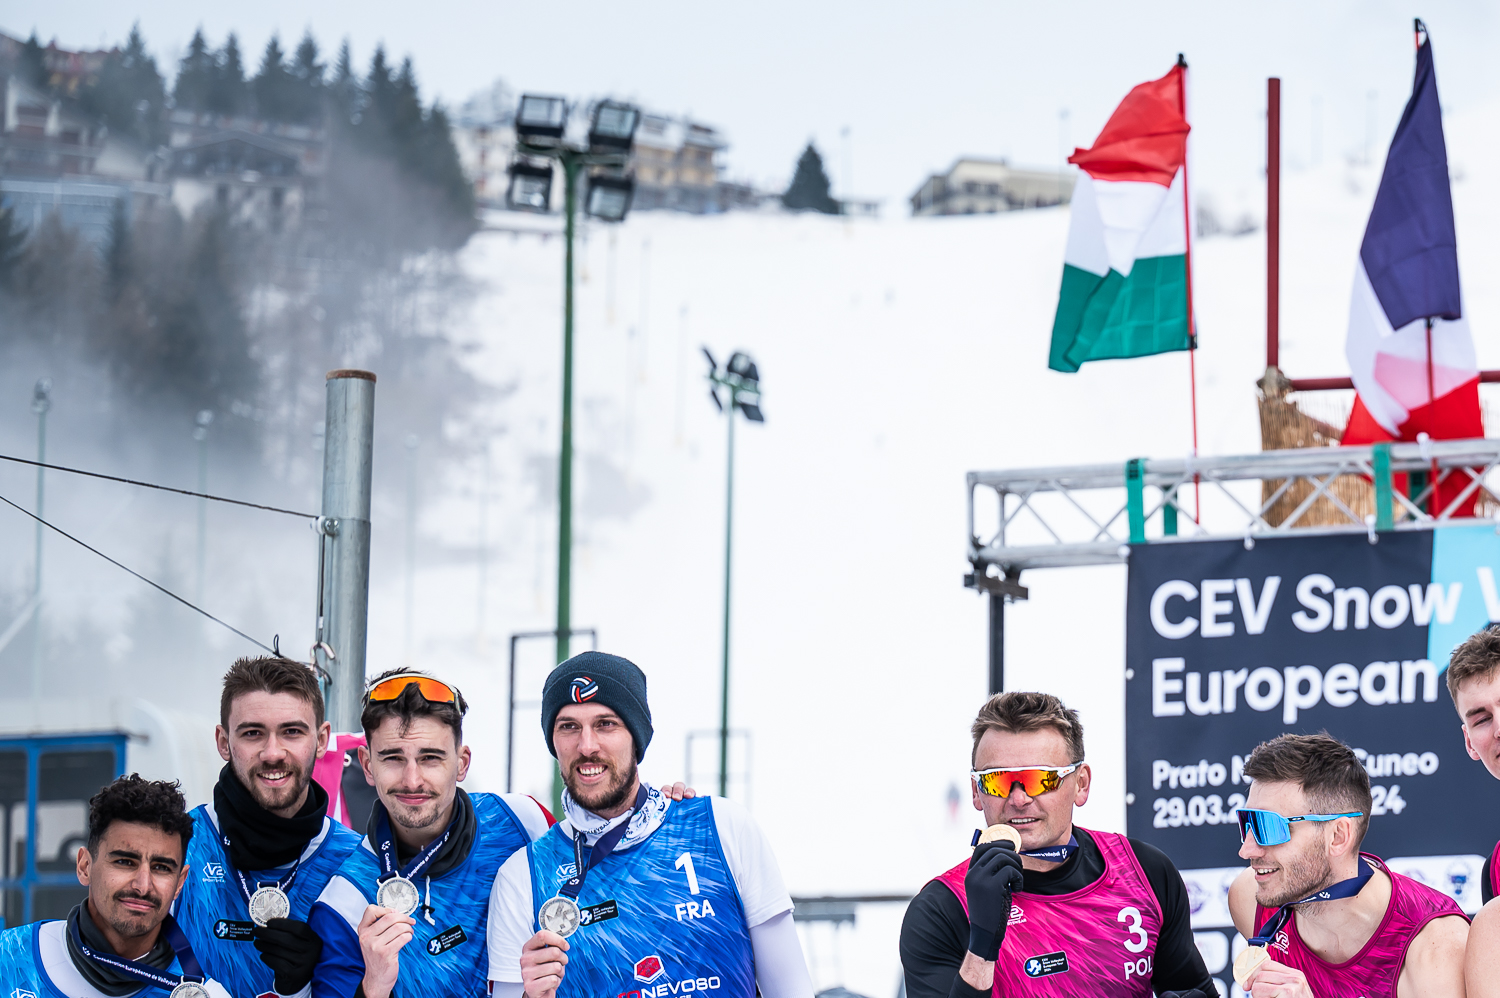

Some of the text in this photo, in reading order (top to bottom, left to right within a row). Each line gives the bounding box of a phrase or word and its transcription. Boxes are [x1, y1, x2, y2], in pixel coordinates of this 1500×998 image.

[1149, 576, 1281, 640] CEV
[1292, 573, 1464, 633] Snow
[1151, 657, 1438, 724] European
[1153, 757, 1227, 791] Prato
[1153, 792, 1246, 829] 29.03.2
[675, 852, 700, 895] 1
[675, 899, 715, 922] FRA
[1117, 906, 1149, 953] 3
[1123, 956, 1153, 980] POL
